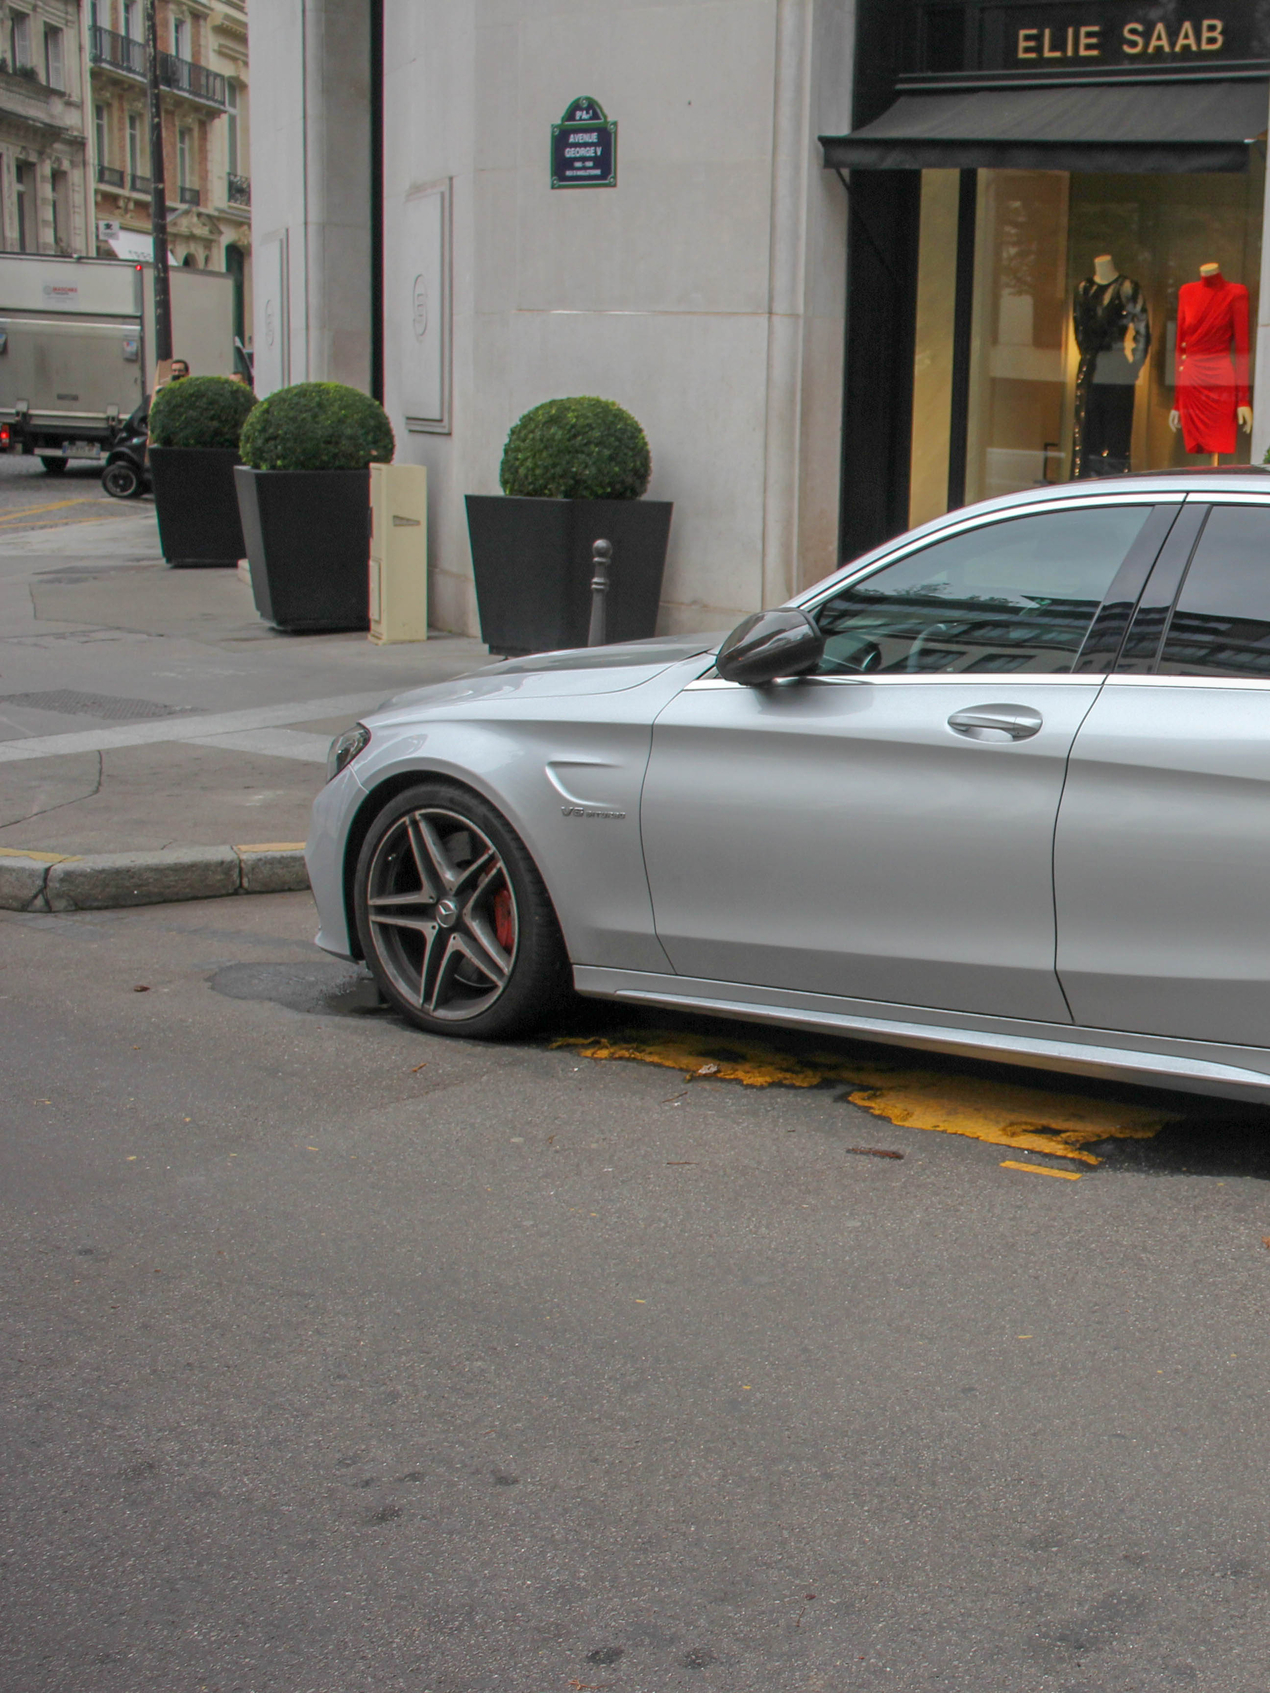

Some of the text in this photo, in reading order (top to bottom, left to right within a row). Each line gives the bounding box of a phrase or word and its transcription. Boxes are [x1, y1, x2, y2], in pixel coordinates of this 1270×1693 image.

[1017, 19, 1223, 58] ELIE SAAB
[569, 133, 598, 143] AVENUE
[565, 147, 602, 157] GEORGE V
